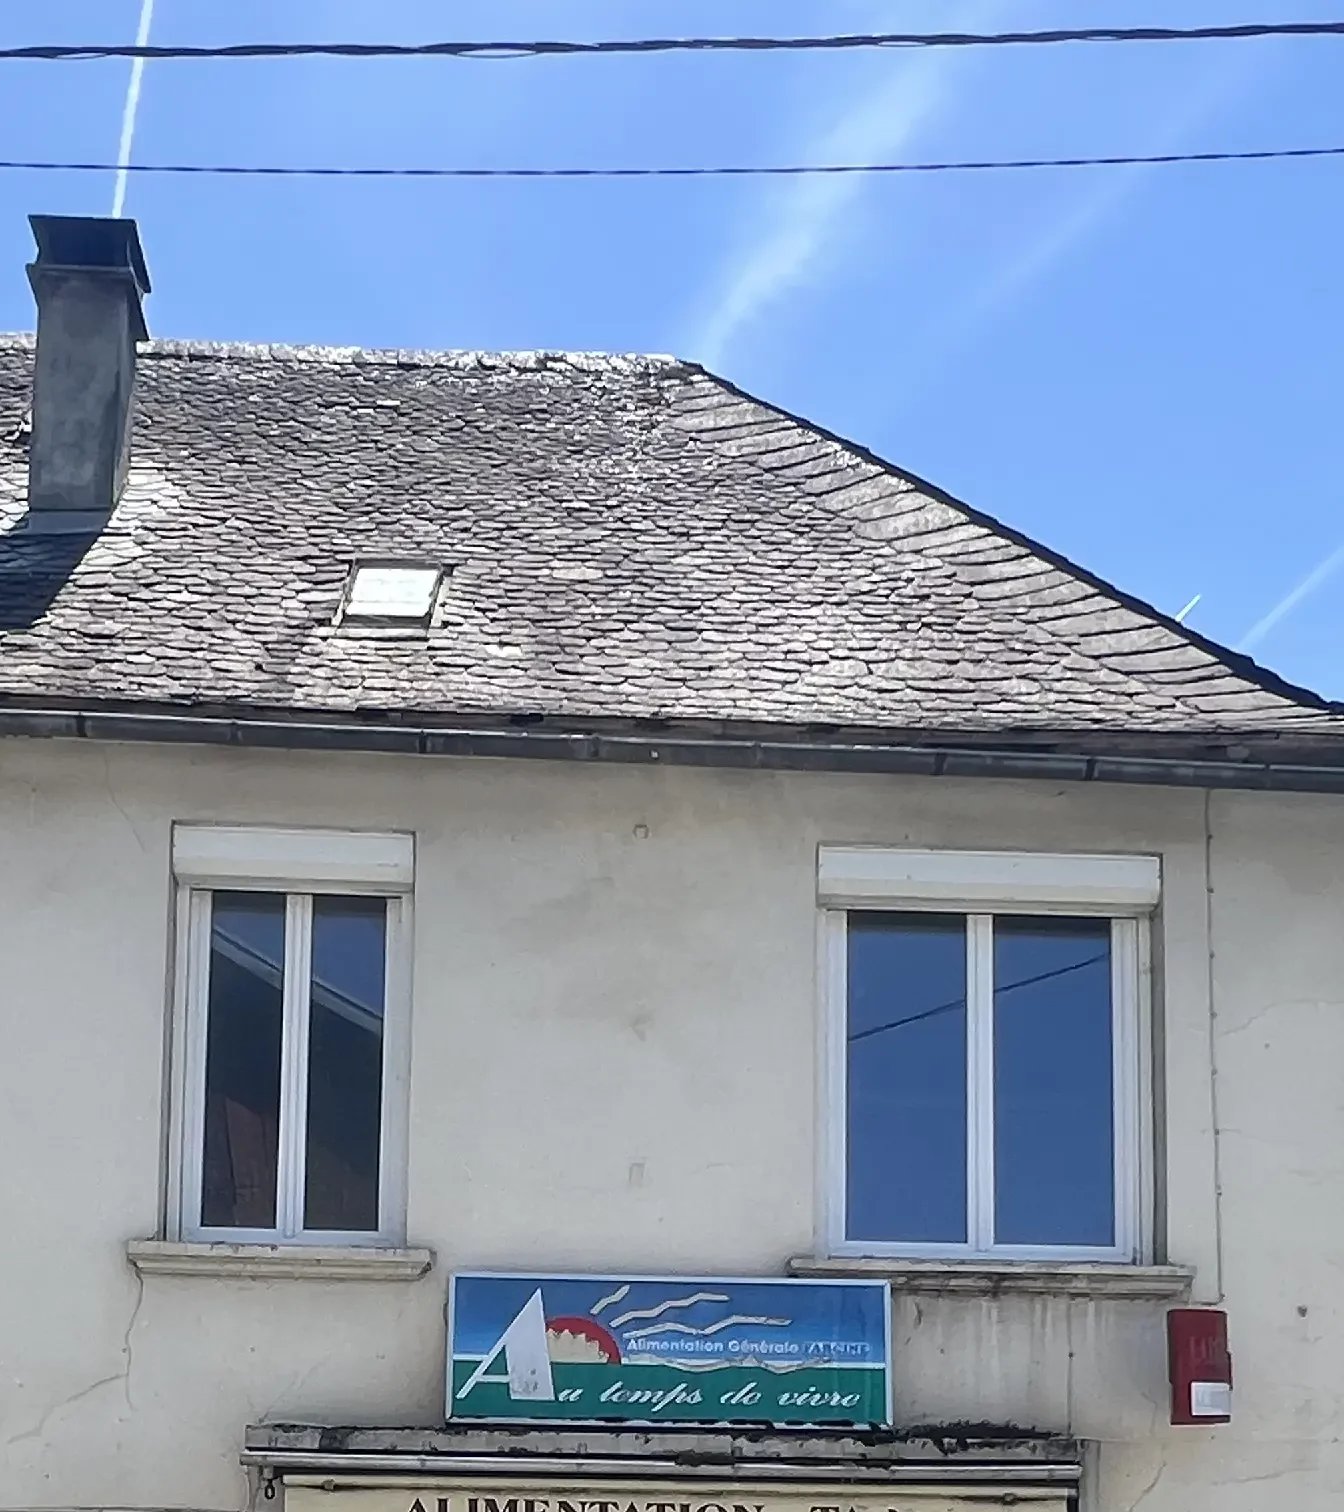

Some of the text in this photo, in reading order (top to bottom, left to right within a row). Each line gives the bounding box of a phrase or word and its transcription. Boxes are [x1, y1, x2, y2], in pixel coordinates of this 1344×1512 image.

[627, 1338, 723, 1352] Alimentation
[729, 1339, 799, 1354] Générale
[600, 1381, 703, 1411] temps
[720, 1383, 762, 1405] de
[778, 1386, 861, 1407] vivre
